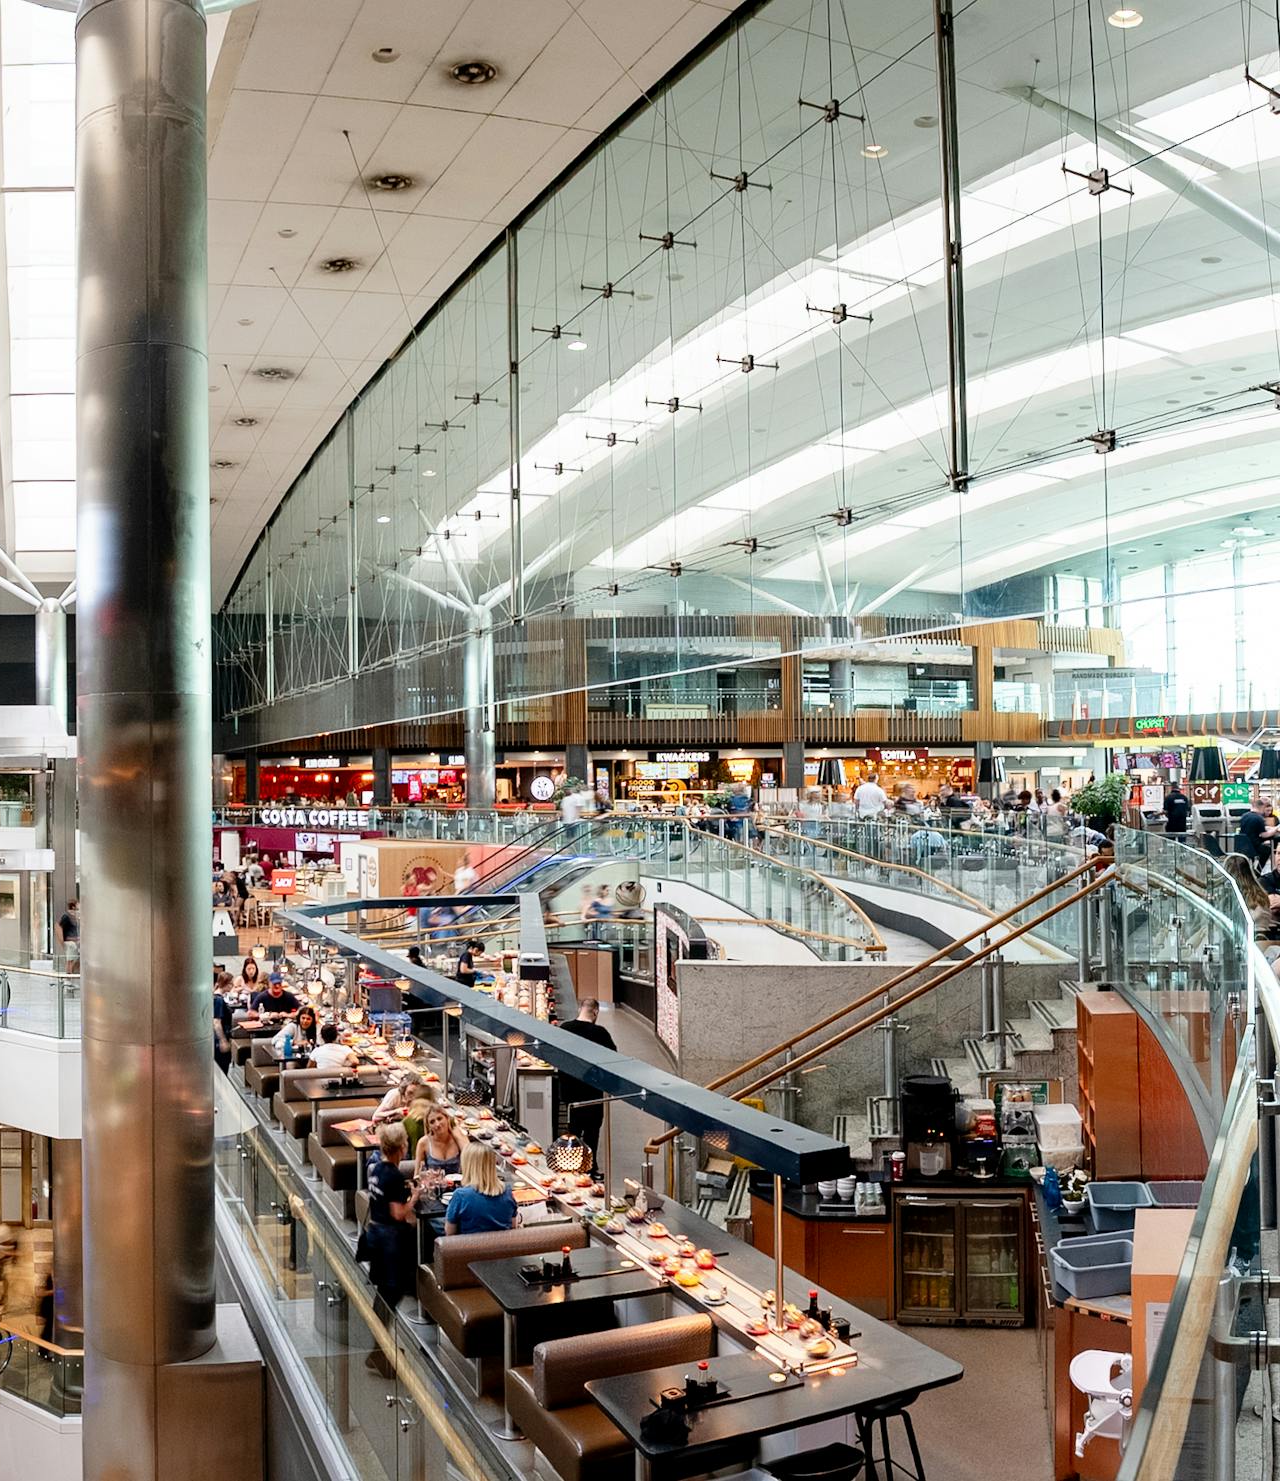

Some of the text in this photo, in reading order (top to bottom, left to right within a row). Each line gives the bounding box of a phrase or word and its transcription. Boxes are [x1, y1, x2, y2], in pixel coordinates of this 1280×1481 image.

[656, 752, 711, 763] KWACKERS
[880, 750, 917, 760] TORTILLA
[261, 808, 369, 827] COSTA COFFEE
